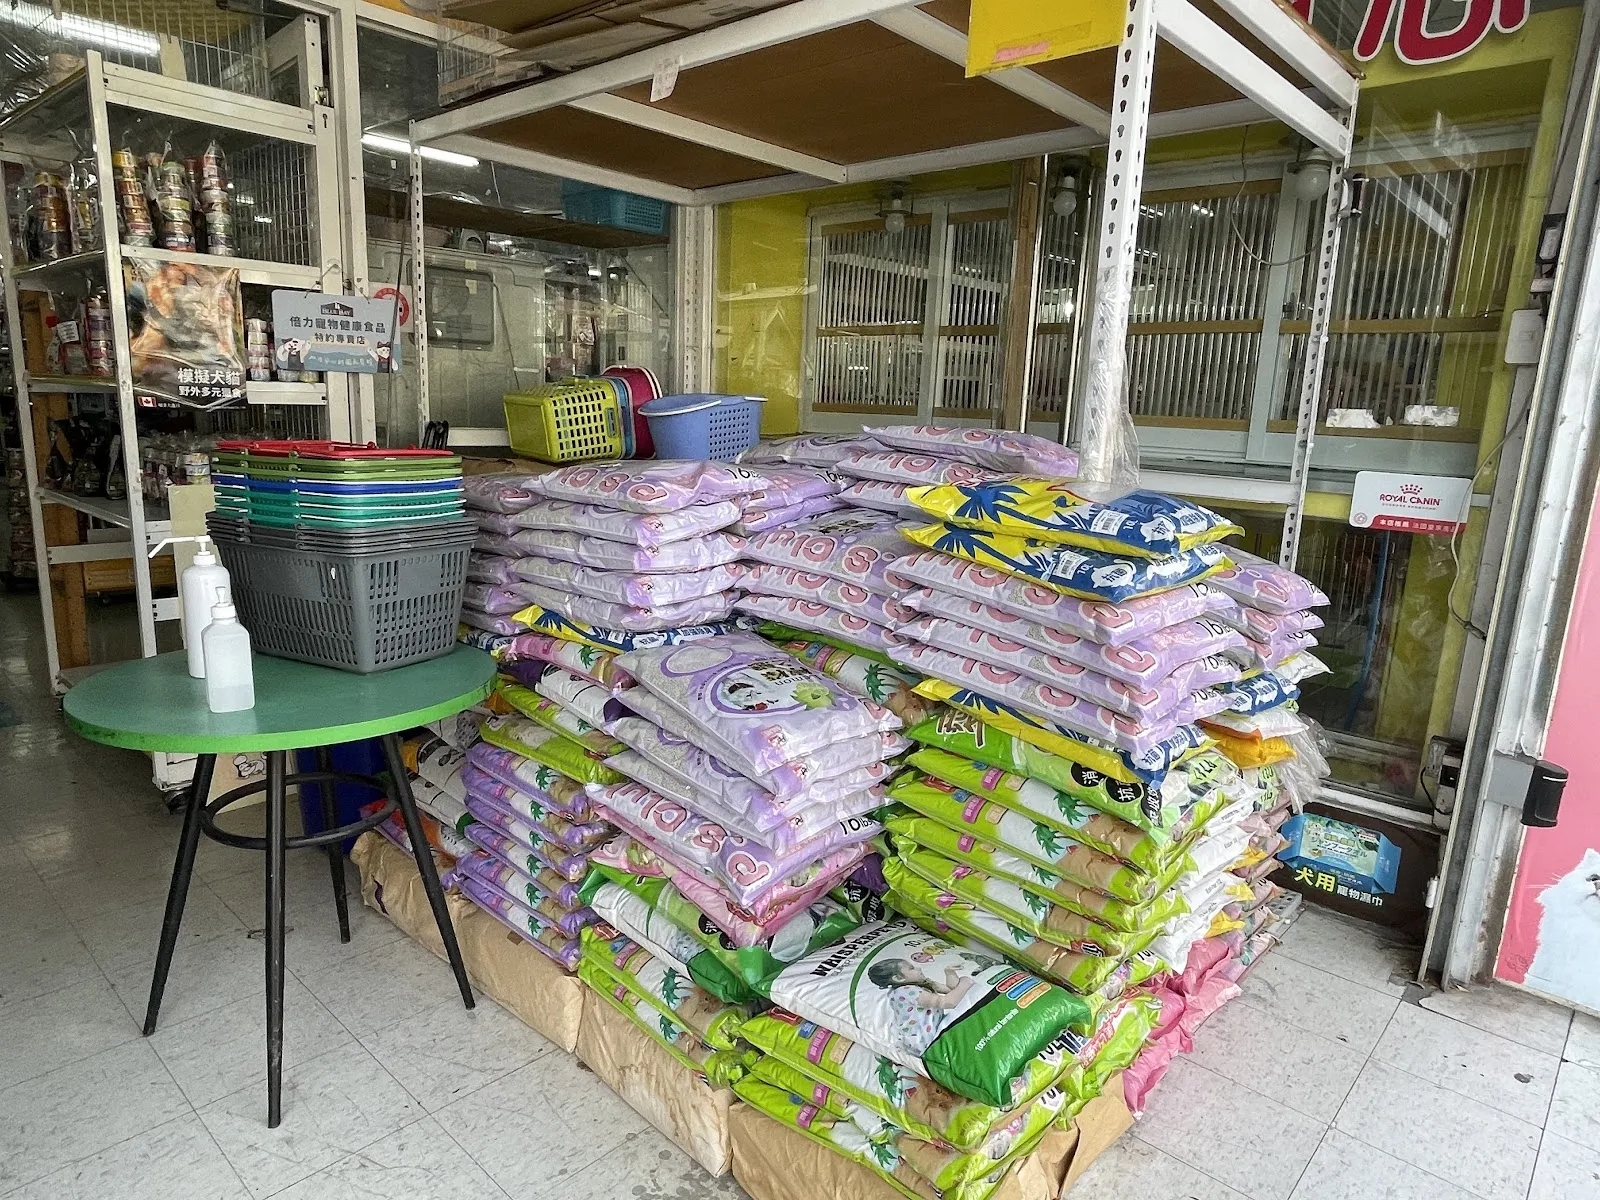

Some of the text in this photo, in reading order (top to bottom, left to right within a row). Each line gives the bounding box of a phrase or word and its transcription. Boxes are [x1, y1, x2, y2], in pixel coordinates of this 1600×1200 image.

[290, 315, 386, 334] 倍力寵物健康食品
[314, 332, 366, 345] 特約專賣店
[177, 368, 241, 386] 模擬犬貓
[1379, 493, 1408, 504] ROYAL
[1409, 496, 1441, 507] CANIN
[838, 816, 875, 836] 10lbs
[1294, 866, 1336, 892] 犬用
[1336, 884, 1383, 907] 寵物濕巾
